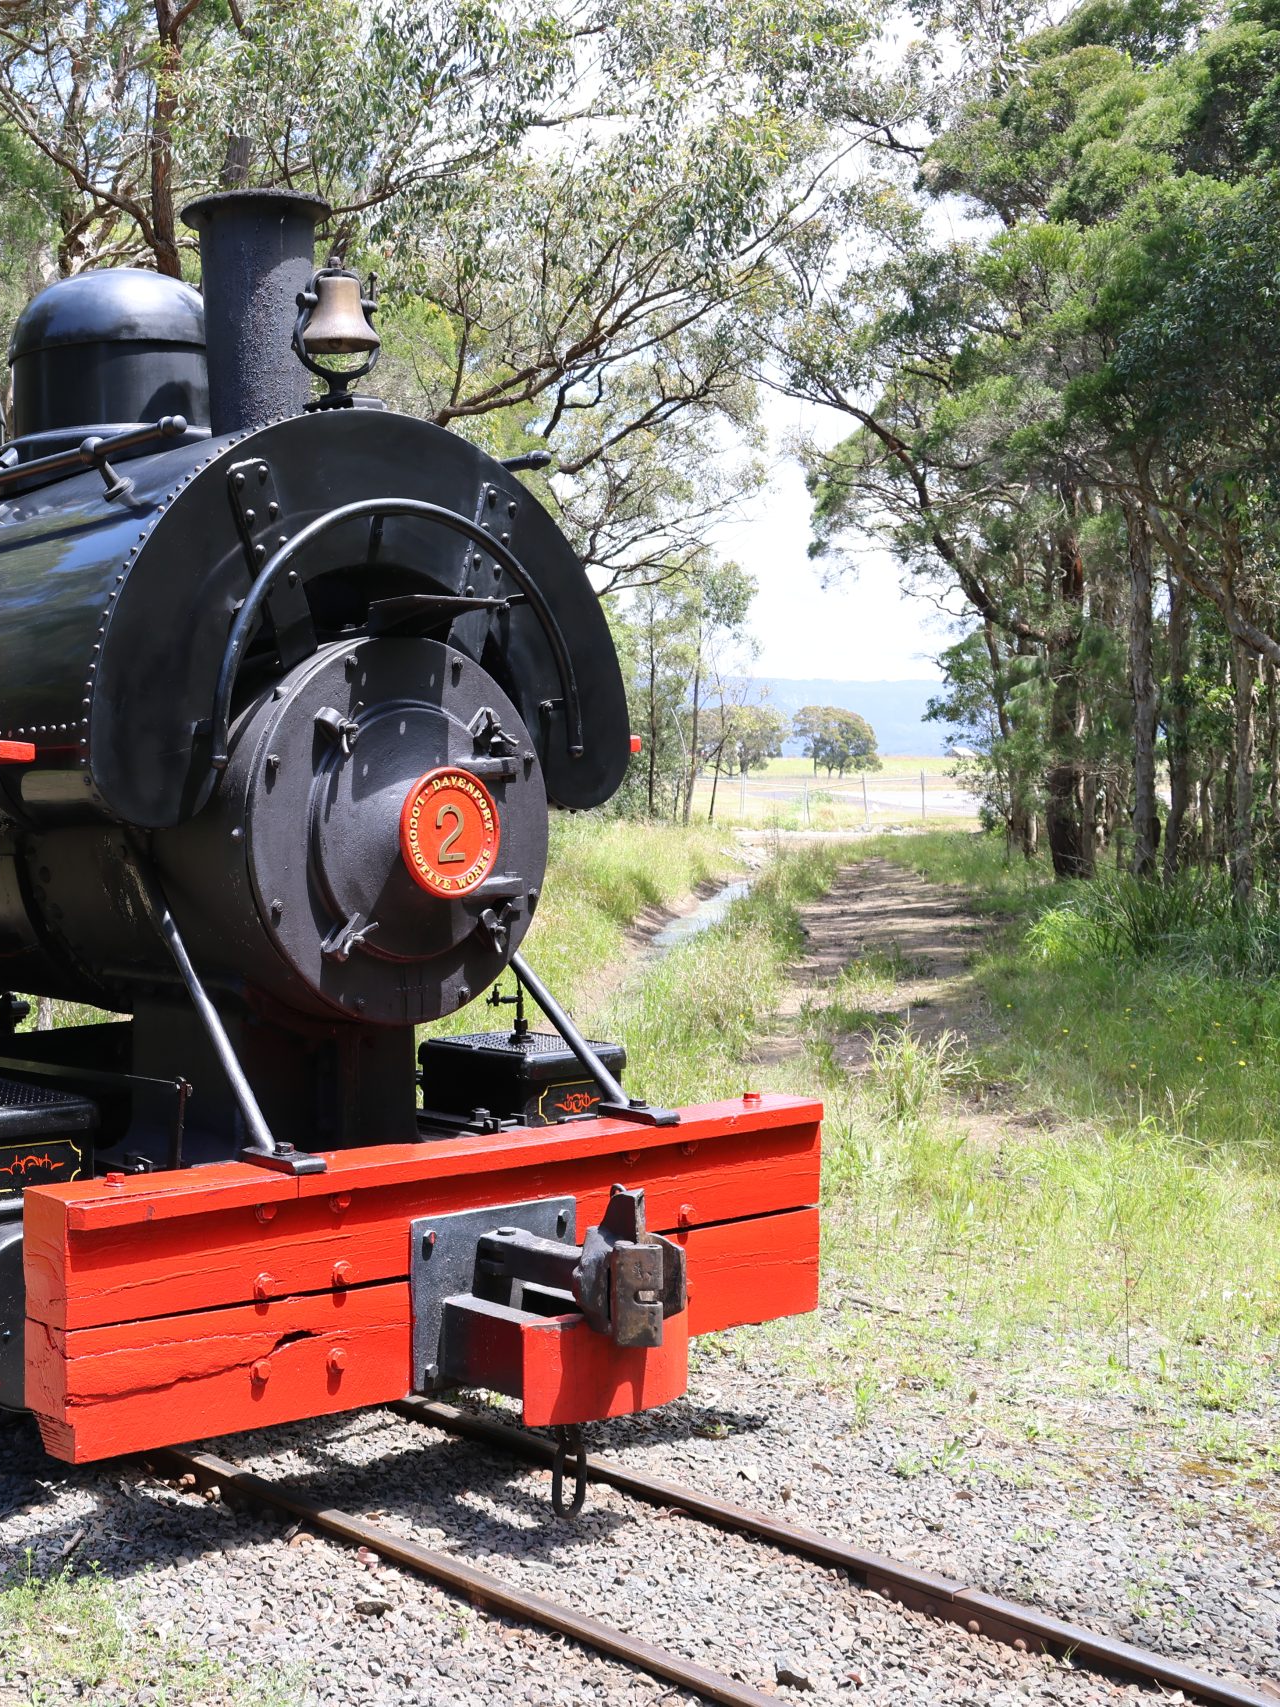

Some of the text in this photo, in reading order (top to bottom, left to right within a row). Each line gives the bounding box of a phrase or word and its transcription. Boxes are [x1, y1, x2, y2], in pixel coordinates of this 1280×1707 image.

[432, 776, 493, 832] DAVENPORT
[436, 804, 465, 863] 2
[409, 796, 491, 890] LOCOMOTIVE WORKS
